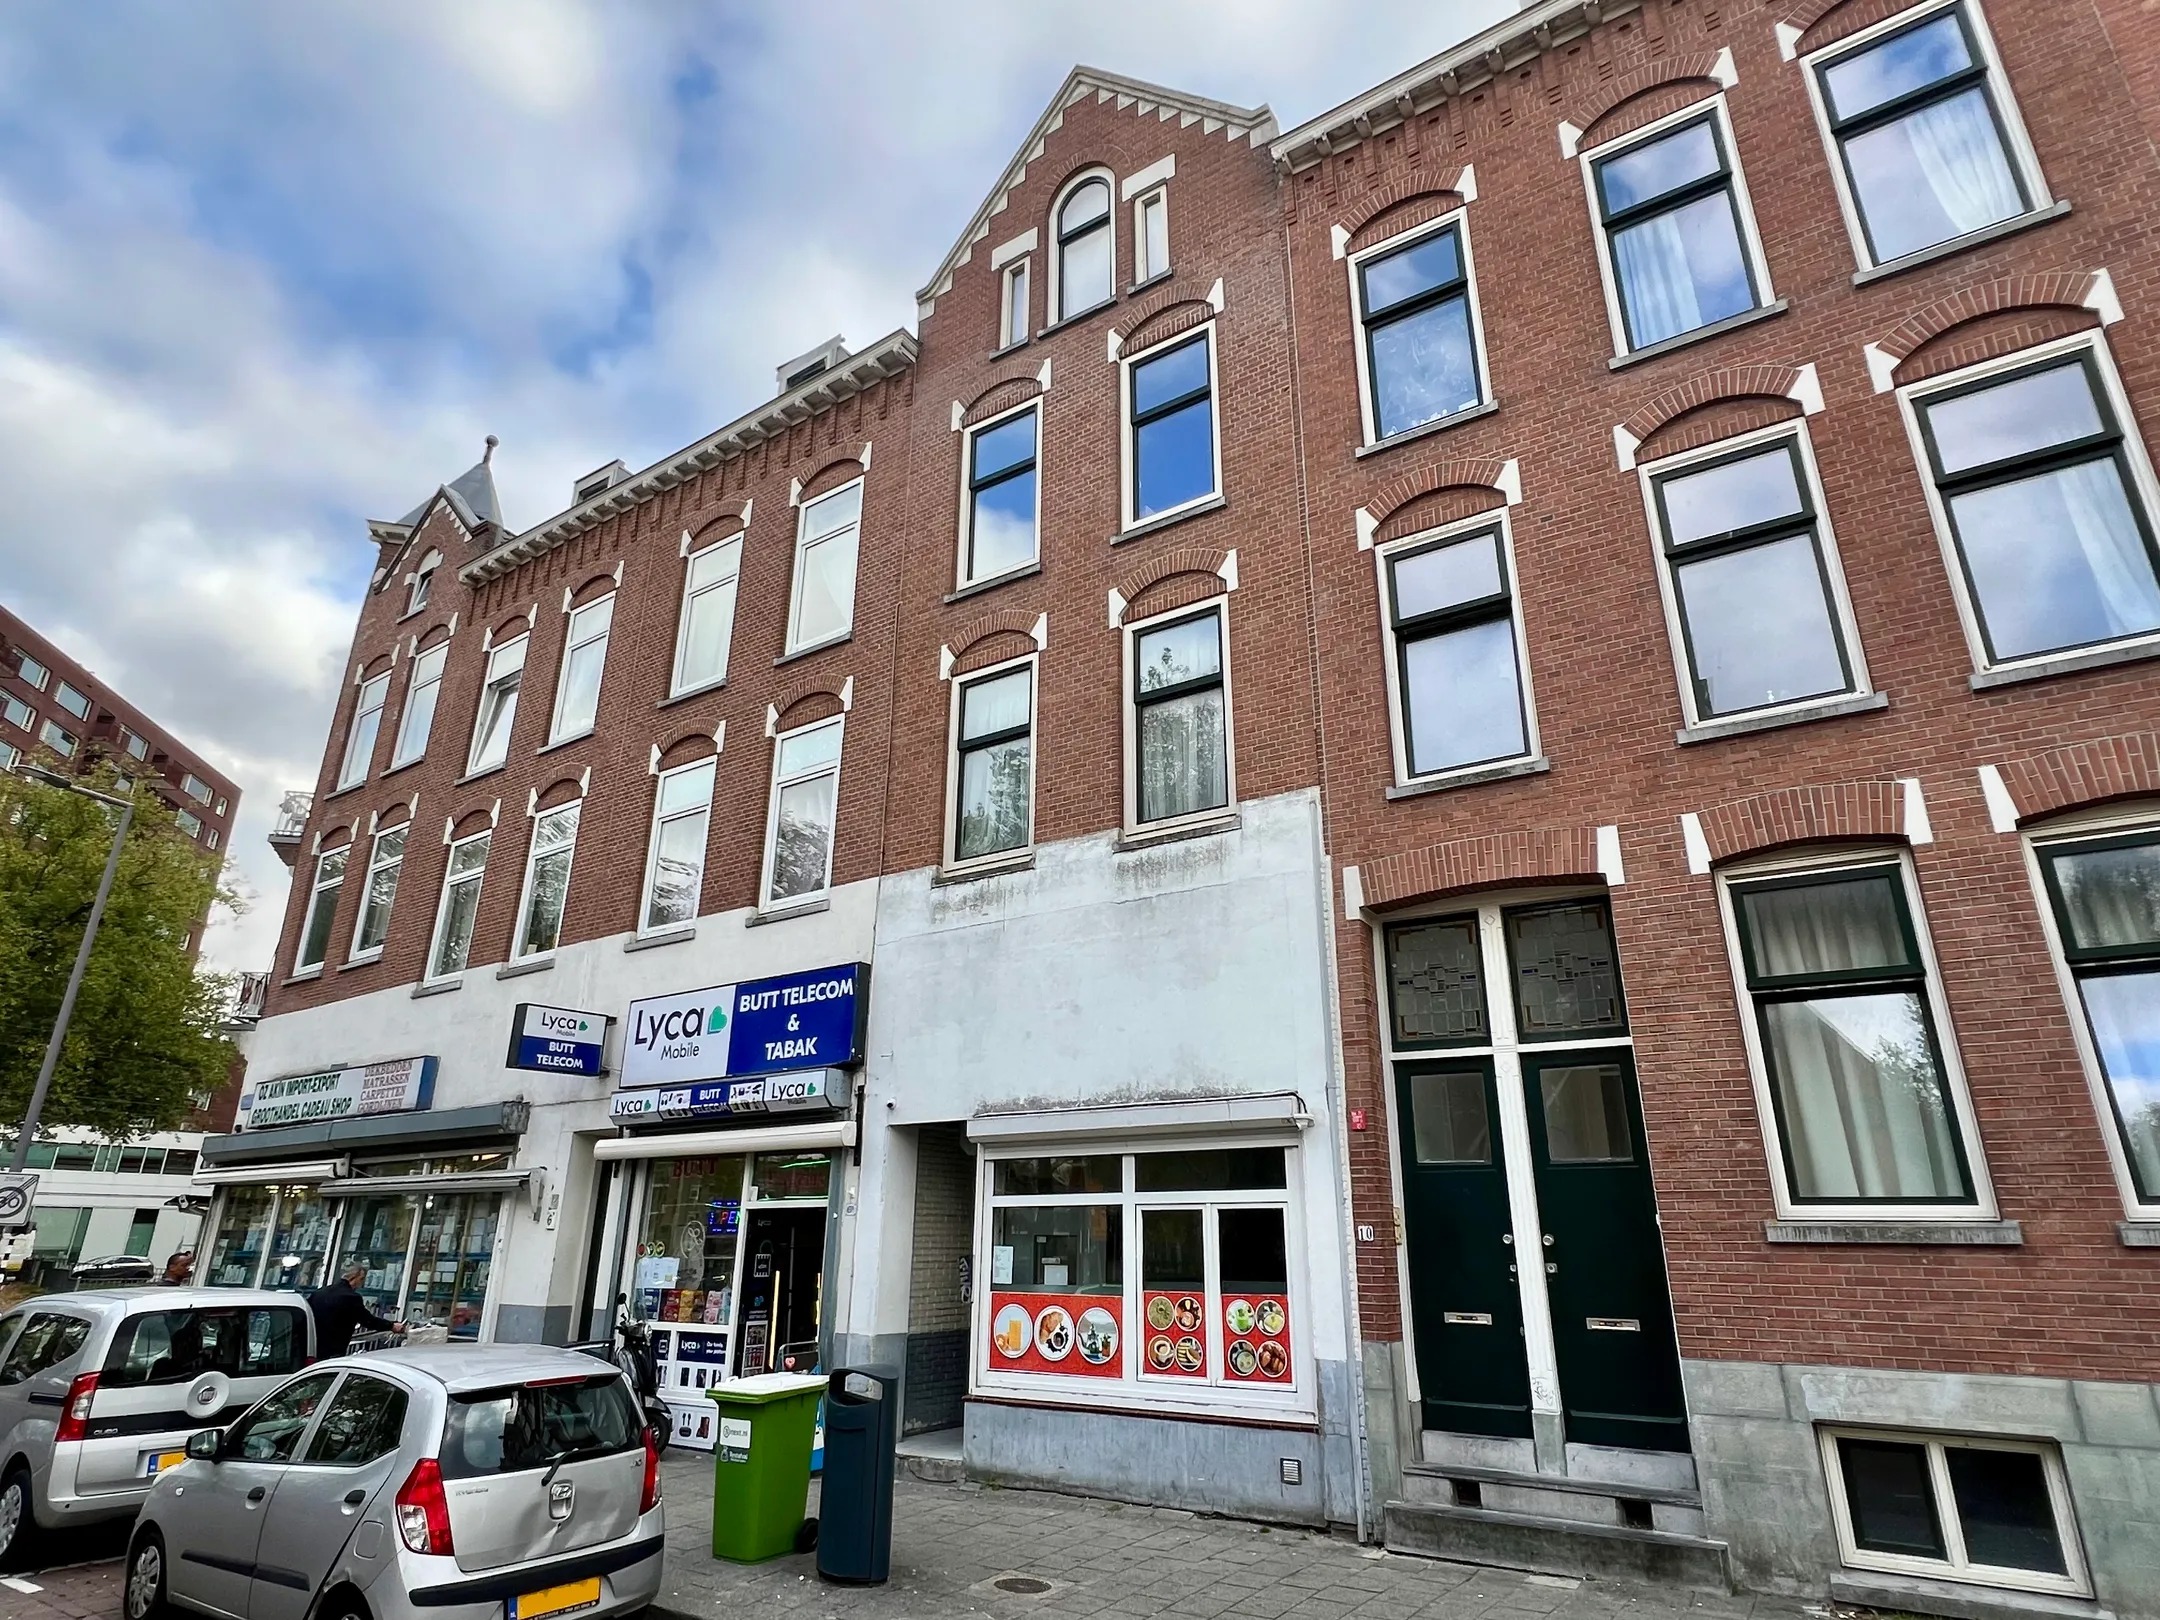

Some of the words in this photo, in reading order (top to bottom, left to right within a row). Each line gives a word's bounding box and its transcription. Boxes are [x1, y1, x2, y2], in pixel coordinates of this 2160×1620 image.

[739, 990, 780, 1013] BUTT
[781, 978, 854, 1007] TELECOM
[541, 1011, 578, 1030] Lyca
[634, 1007, 705, 1051] Lyca
[787, 1014, 800, 1031] &
[548, 1042, 576, 1054] BUTT
[660, 1042, 700, 1061] Mobile
[765, 1037, 817, 1061] TABAK
[536, 1054, 583, 1069] TELECOM
[363, 1073, 410, 1089] MATRASSEN
[360, 1085, 406, 1101] CARPETTEN
[699, 1088, 722, 1101] BUTT
[772, 1083, 806, 1100] Lyca
[251, 1102, 300, 1125] GROOTHANDEL
[301, 1098, 331, 1119] CADEAU
[330, 1097, 352, 1115] SHOP
[614, 1098, 642, 1115] Lyca
[690, 1102, 731, 1114] TELECOM
[1359, 1228, 1373, 1241] 10
